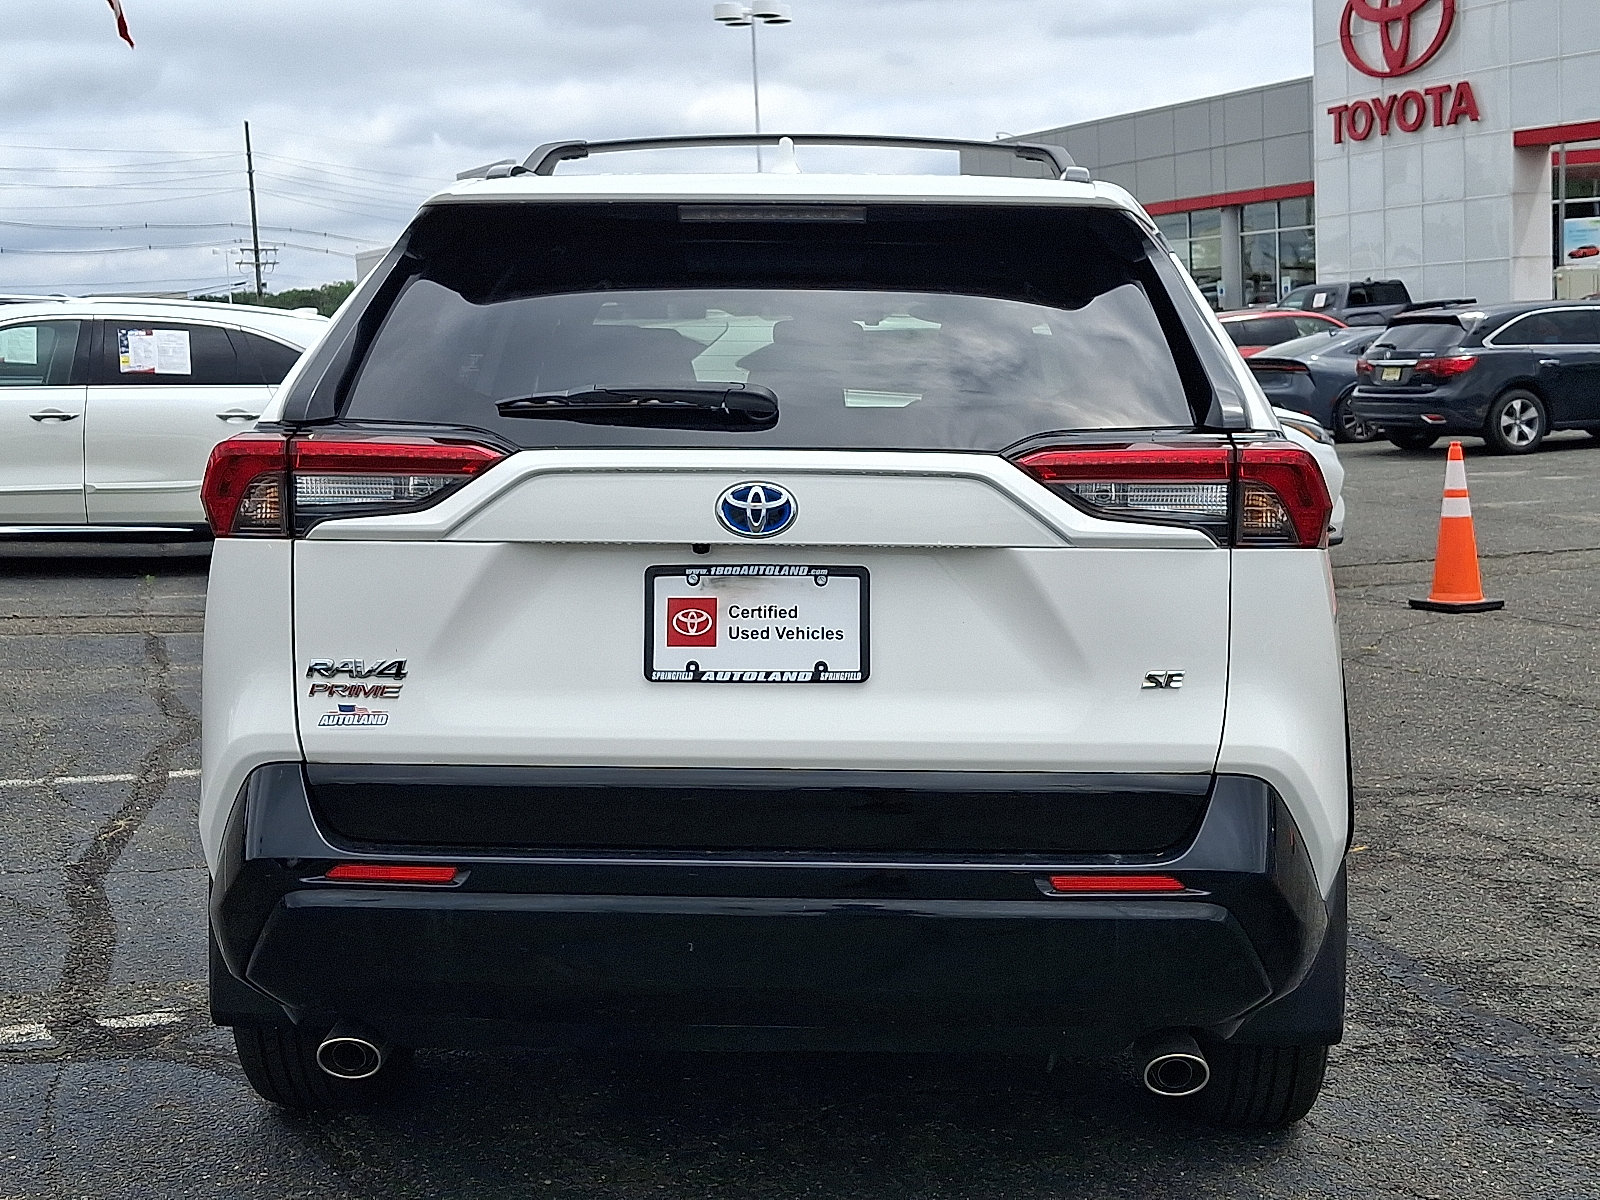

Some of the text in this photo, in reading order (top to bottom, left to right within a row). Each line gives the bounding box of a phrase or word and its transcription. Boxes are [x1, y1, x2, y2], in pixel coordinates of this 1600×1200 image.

[1327, 81, 1480, 144] TOYOTA
[728, 605, 798, 619] Certified
[728, 626, 844, 640] Used Vehicles
[306, 658, 409, 680] RAV4
[651, 671, 862, 682] SPRINGFIELD AUTOLAND SPRINGFIELD
[1141, 670, 1186, 689] SE
[309, 682, 404, 699] PRIME
[318, 714, 390, 726] AUTOLAND
